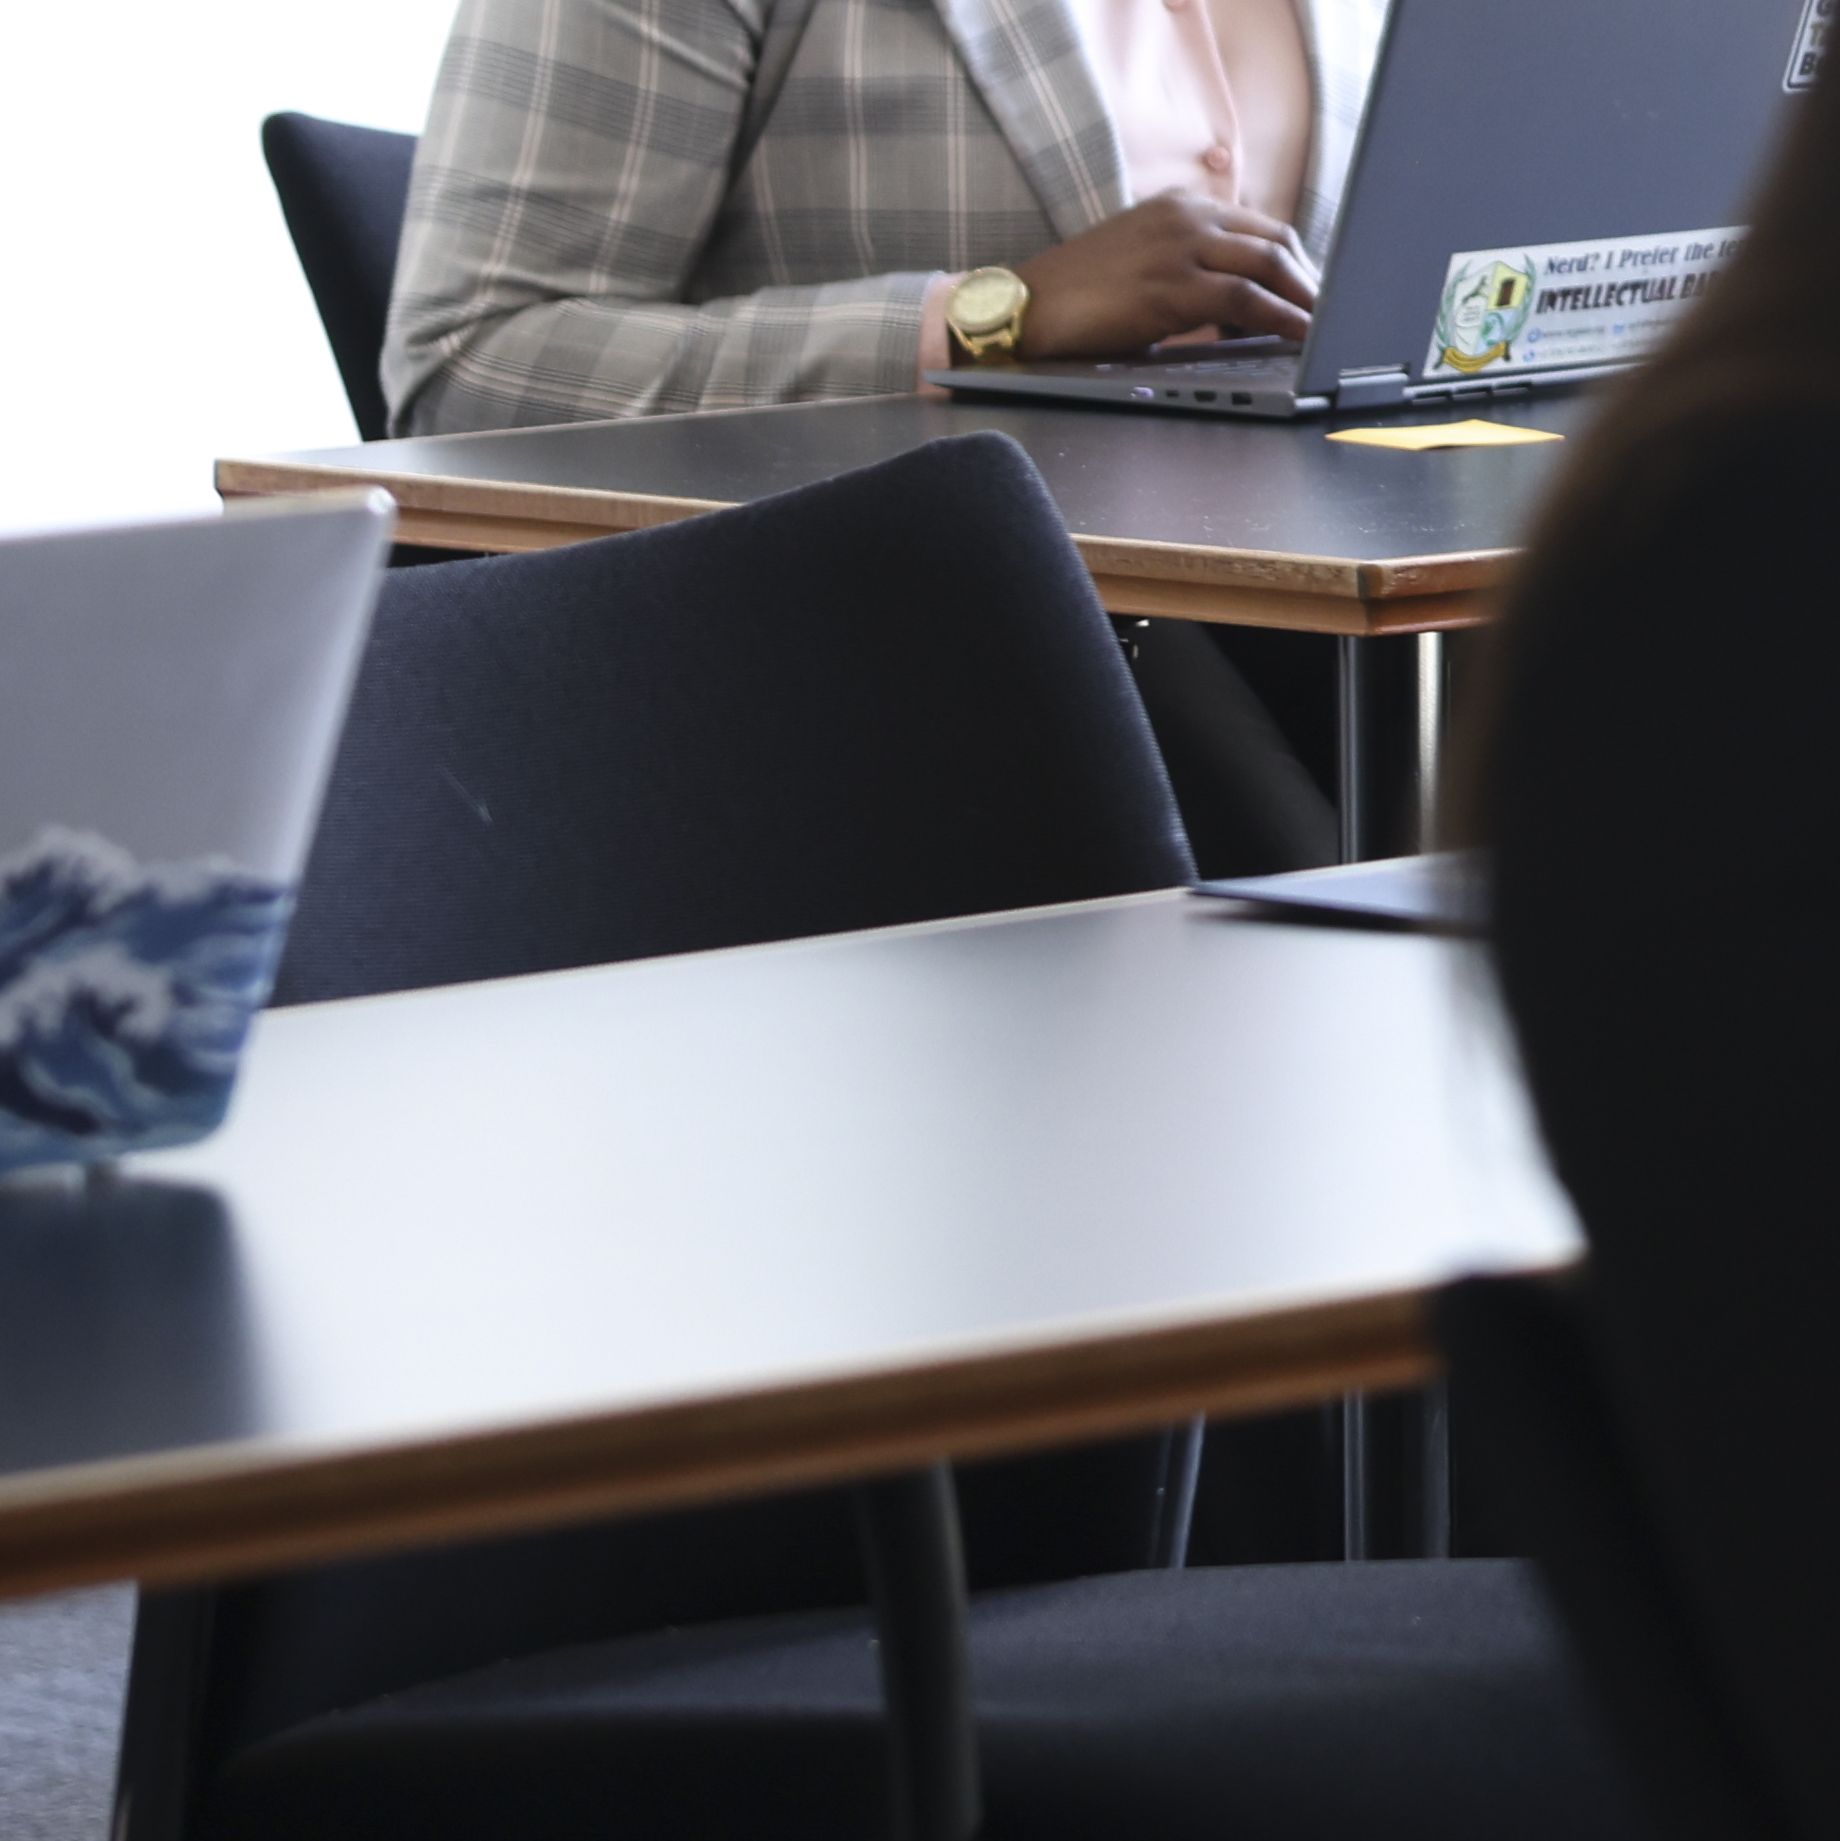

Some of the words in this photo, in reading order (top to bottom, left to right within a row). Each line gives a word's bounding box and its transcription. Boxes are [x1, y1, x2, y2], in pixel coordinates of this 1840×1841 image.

[1545, 250, 1601, 275] Nerd?
[1604, 249, 1615, 270] I
[1618, 245, 1680, 269] Prefer
[1684, 241, 1714, 262] the
[1535, 275, 1678, 314] INTELLECTUAL
